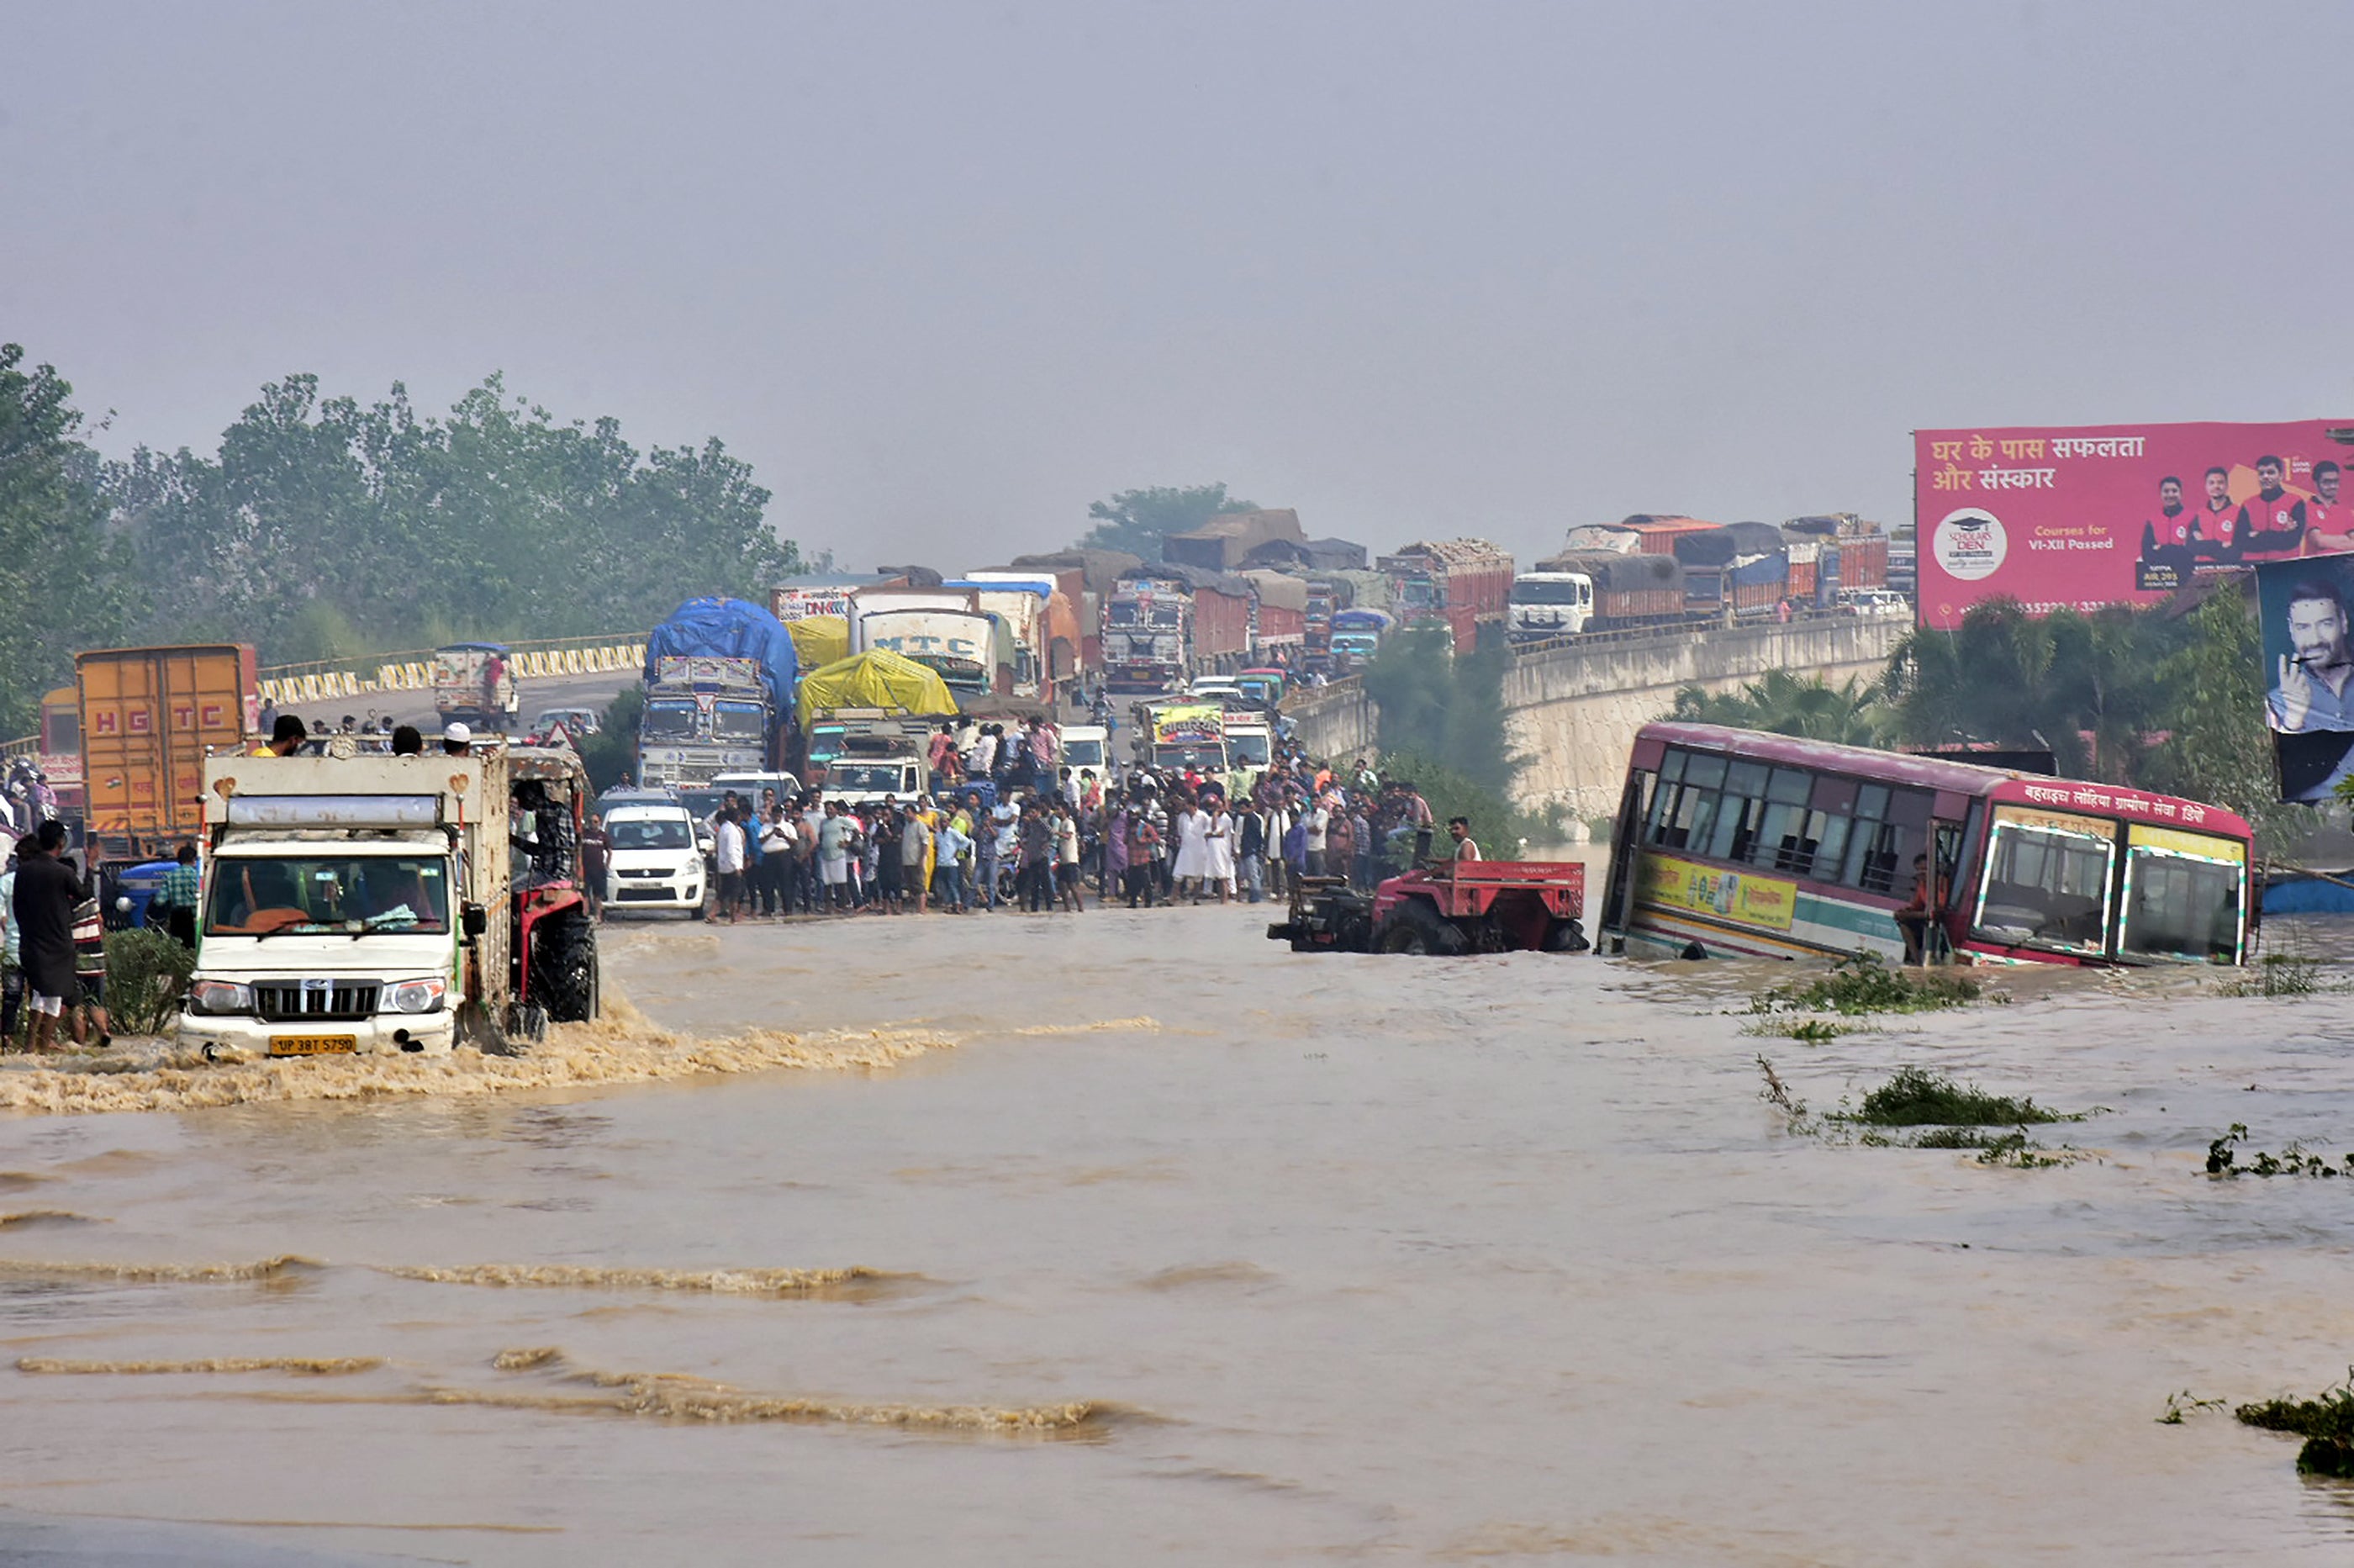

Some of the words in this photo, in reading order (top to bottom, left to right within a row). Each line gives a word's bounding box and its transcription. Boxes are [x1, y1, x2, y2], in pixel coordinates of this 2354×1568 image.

[1931, 441, 1963, 461] घर
[1969, 434, 1993, 461] के
[1999, 439, 2045, 460] पास
[2051, 436, 2146, 458] सफलता
[1933, 462, 1974, 491] और
[1978, 463, 2056, 490] संस्कार
[2035, 525, 2084, 536] Courses
[2088, 524, 2108, 536] for
[1957, 541, 1985, 551] DEN
[2028, 539, 2065, 550] VI-XII
[2068, 536, 2114, 551] Passed
[874, 636, 974, 655] MTC
[278, 1039, 294, 1052] UP
